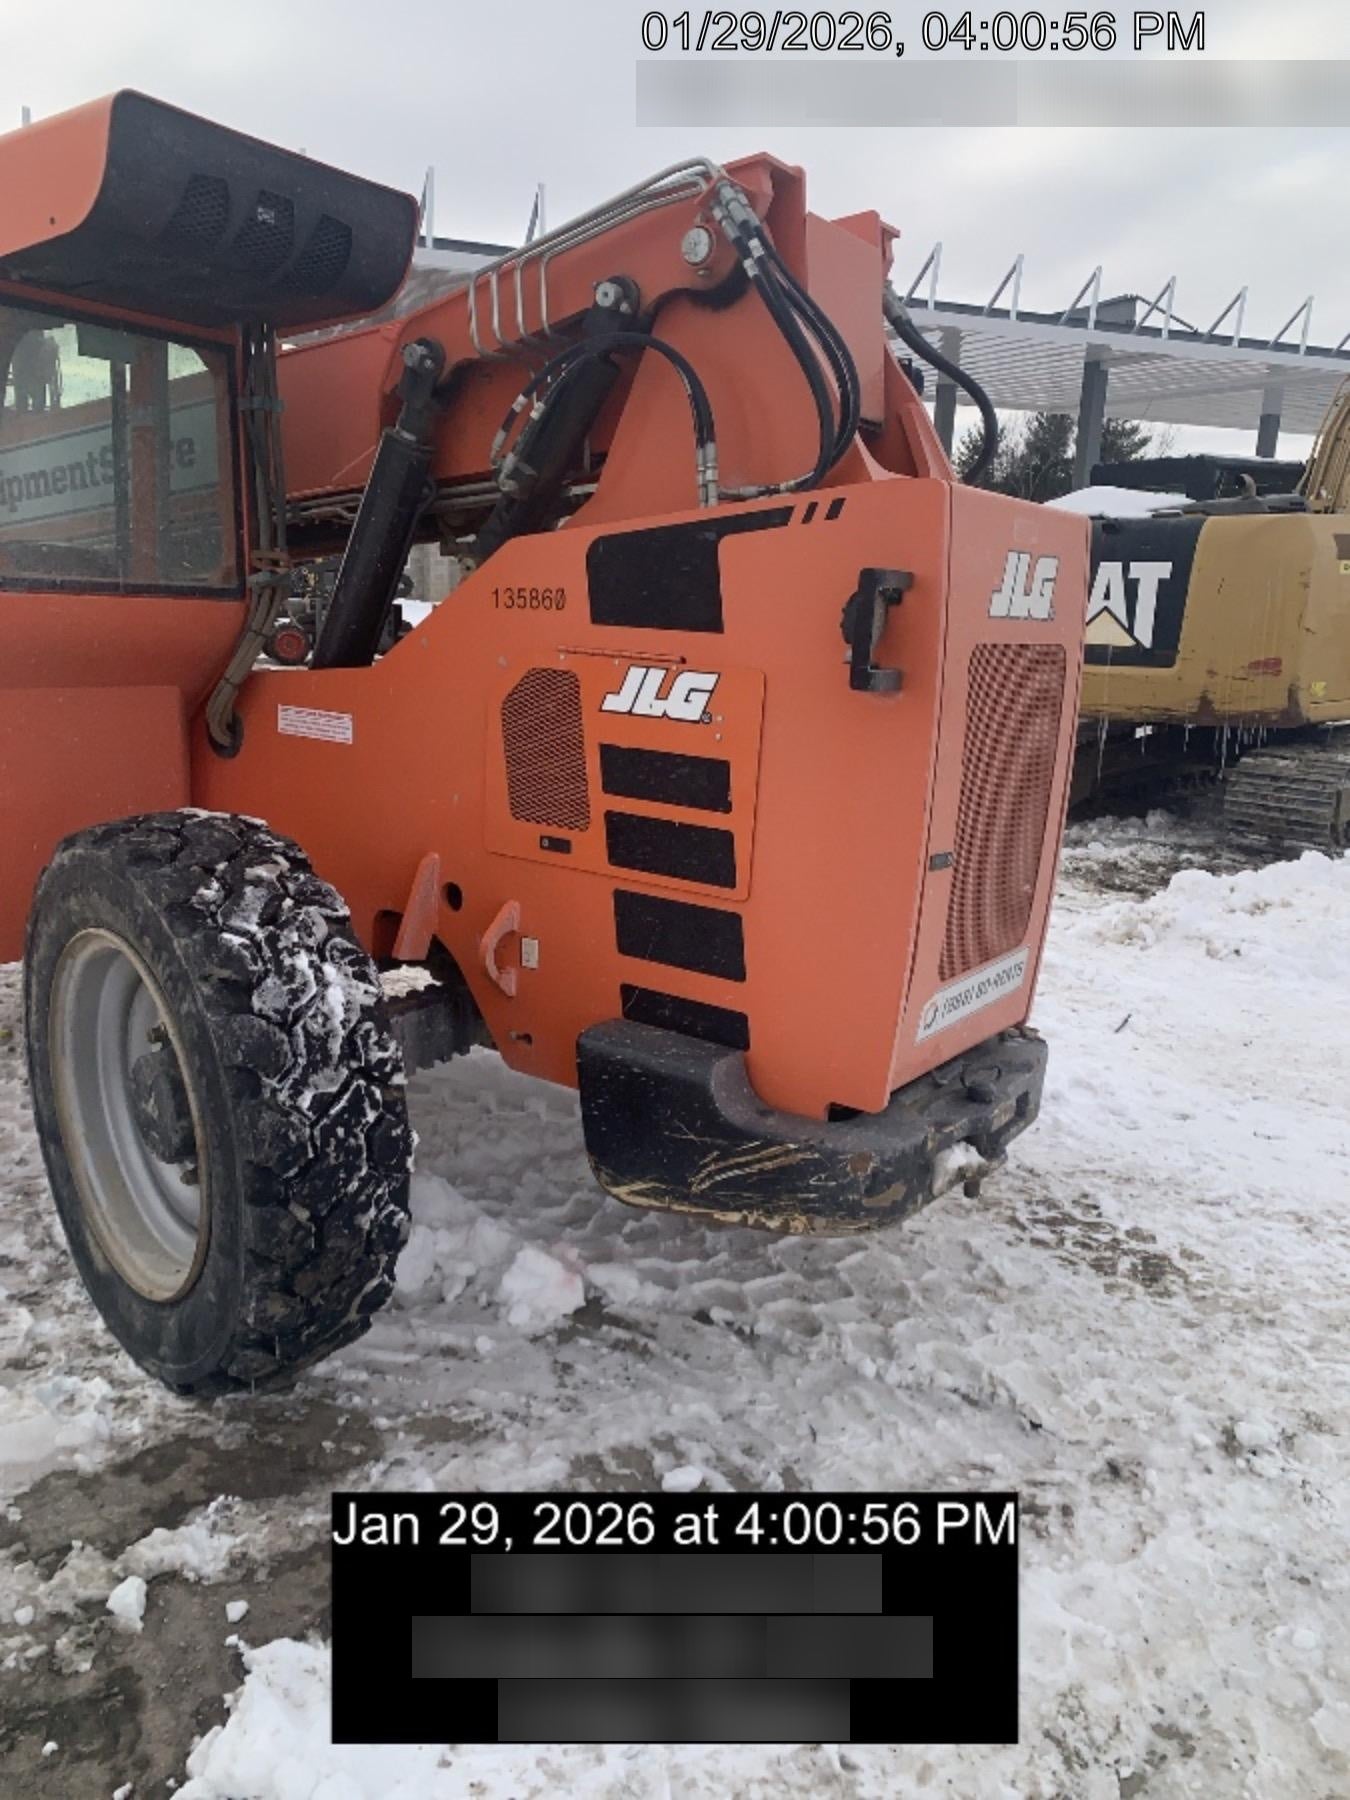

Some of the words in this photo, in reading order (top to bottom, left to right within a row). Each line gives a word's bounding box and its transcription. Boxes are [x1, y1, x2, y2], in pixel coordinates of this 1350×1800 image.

[491, 587, 567, 611] 135860
[987, 550, 1059, 621] JLG
[1085, 561, 1173, 649] AT
[598, 664, 721, 723] JLG
